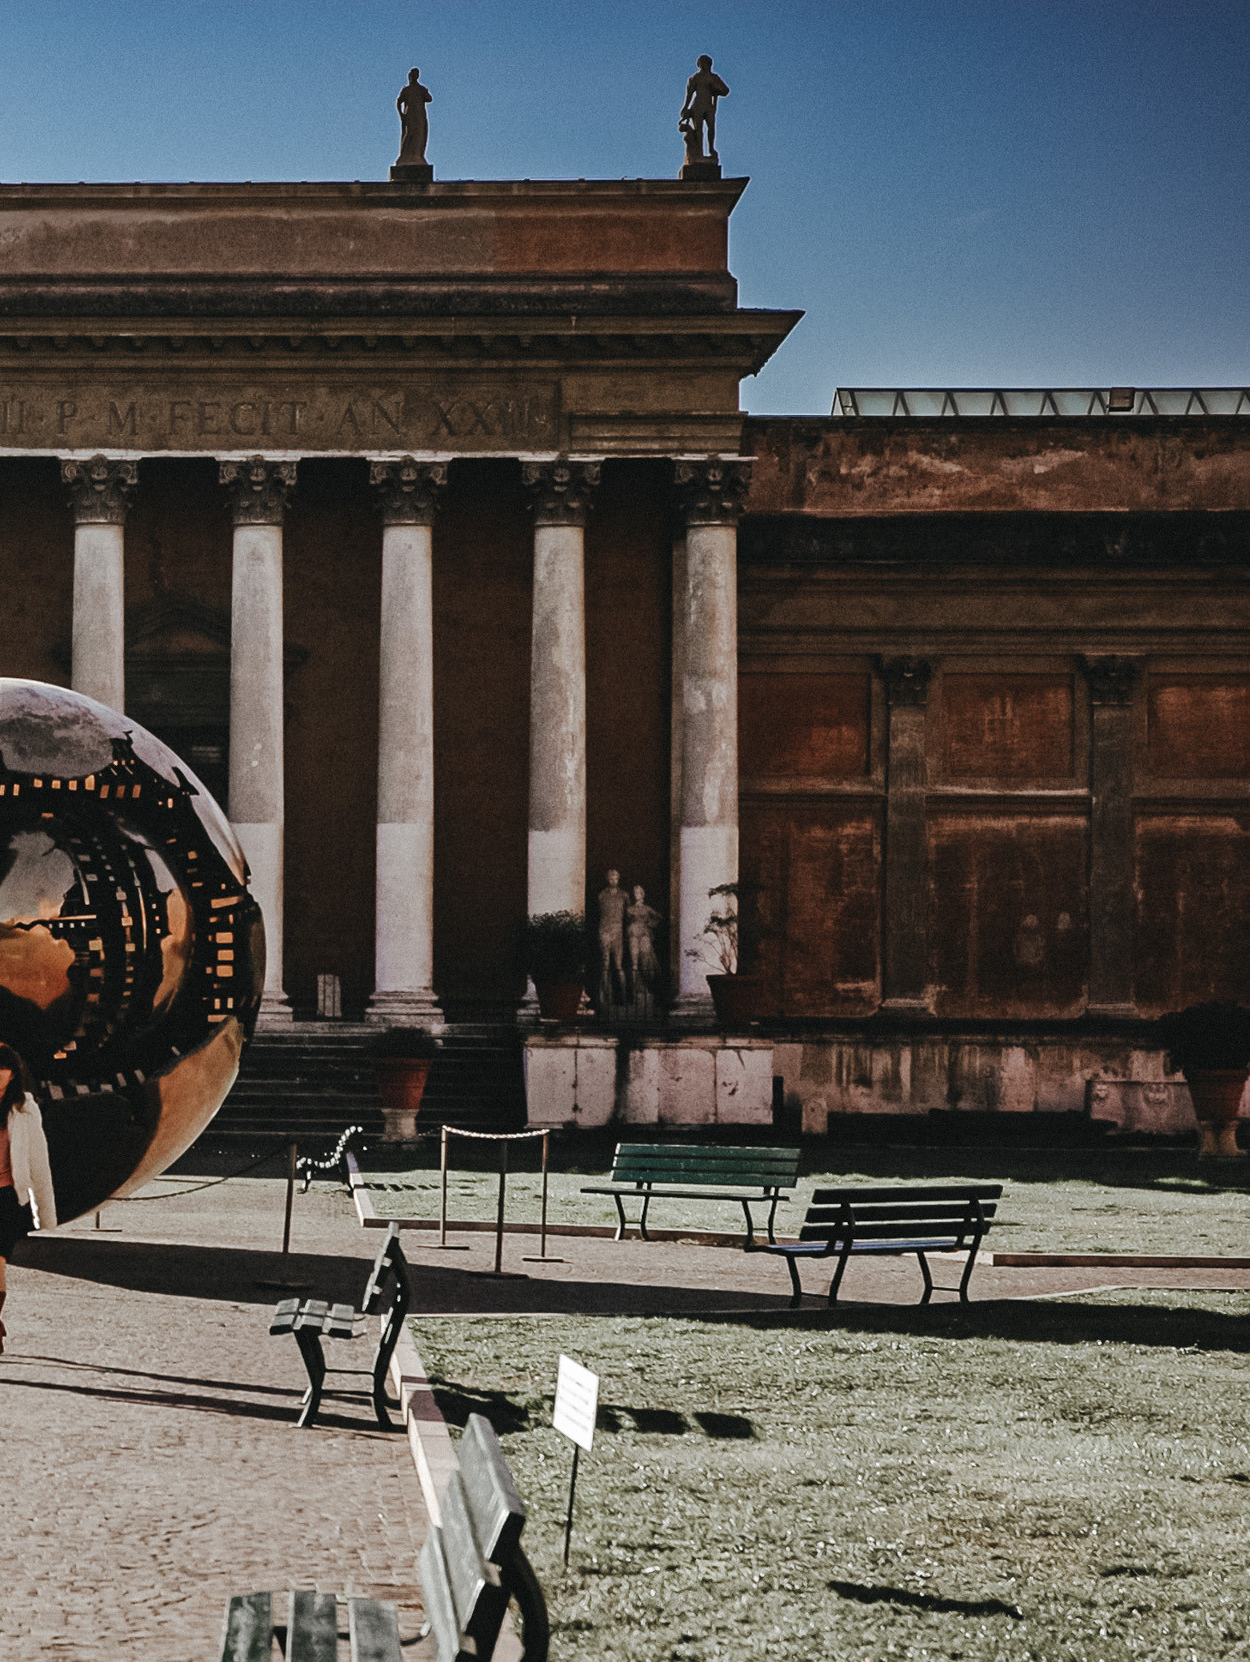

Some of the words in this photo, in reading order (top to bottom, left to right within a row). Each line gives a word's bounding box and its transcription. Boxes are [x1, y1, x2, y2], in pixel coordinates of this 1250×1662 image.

[55, 400, 79, 436] P
[107, 400, 140, 436] M
[167, 400, 307, 437] FECIT
[336, 399, 406, 436] AN
